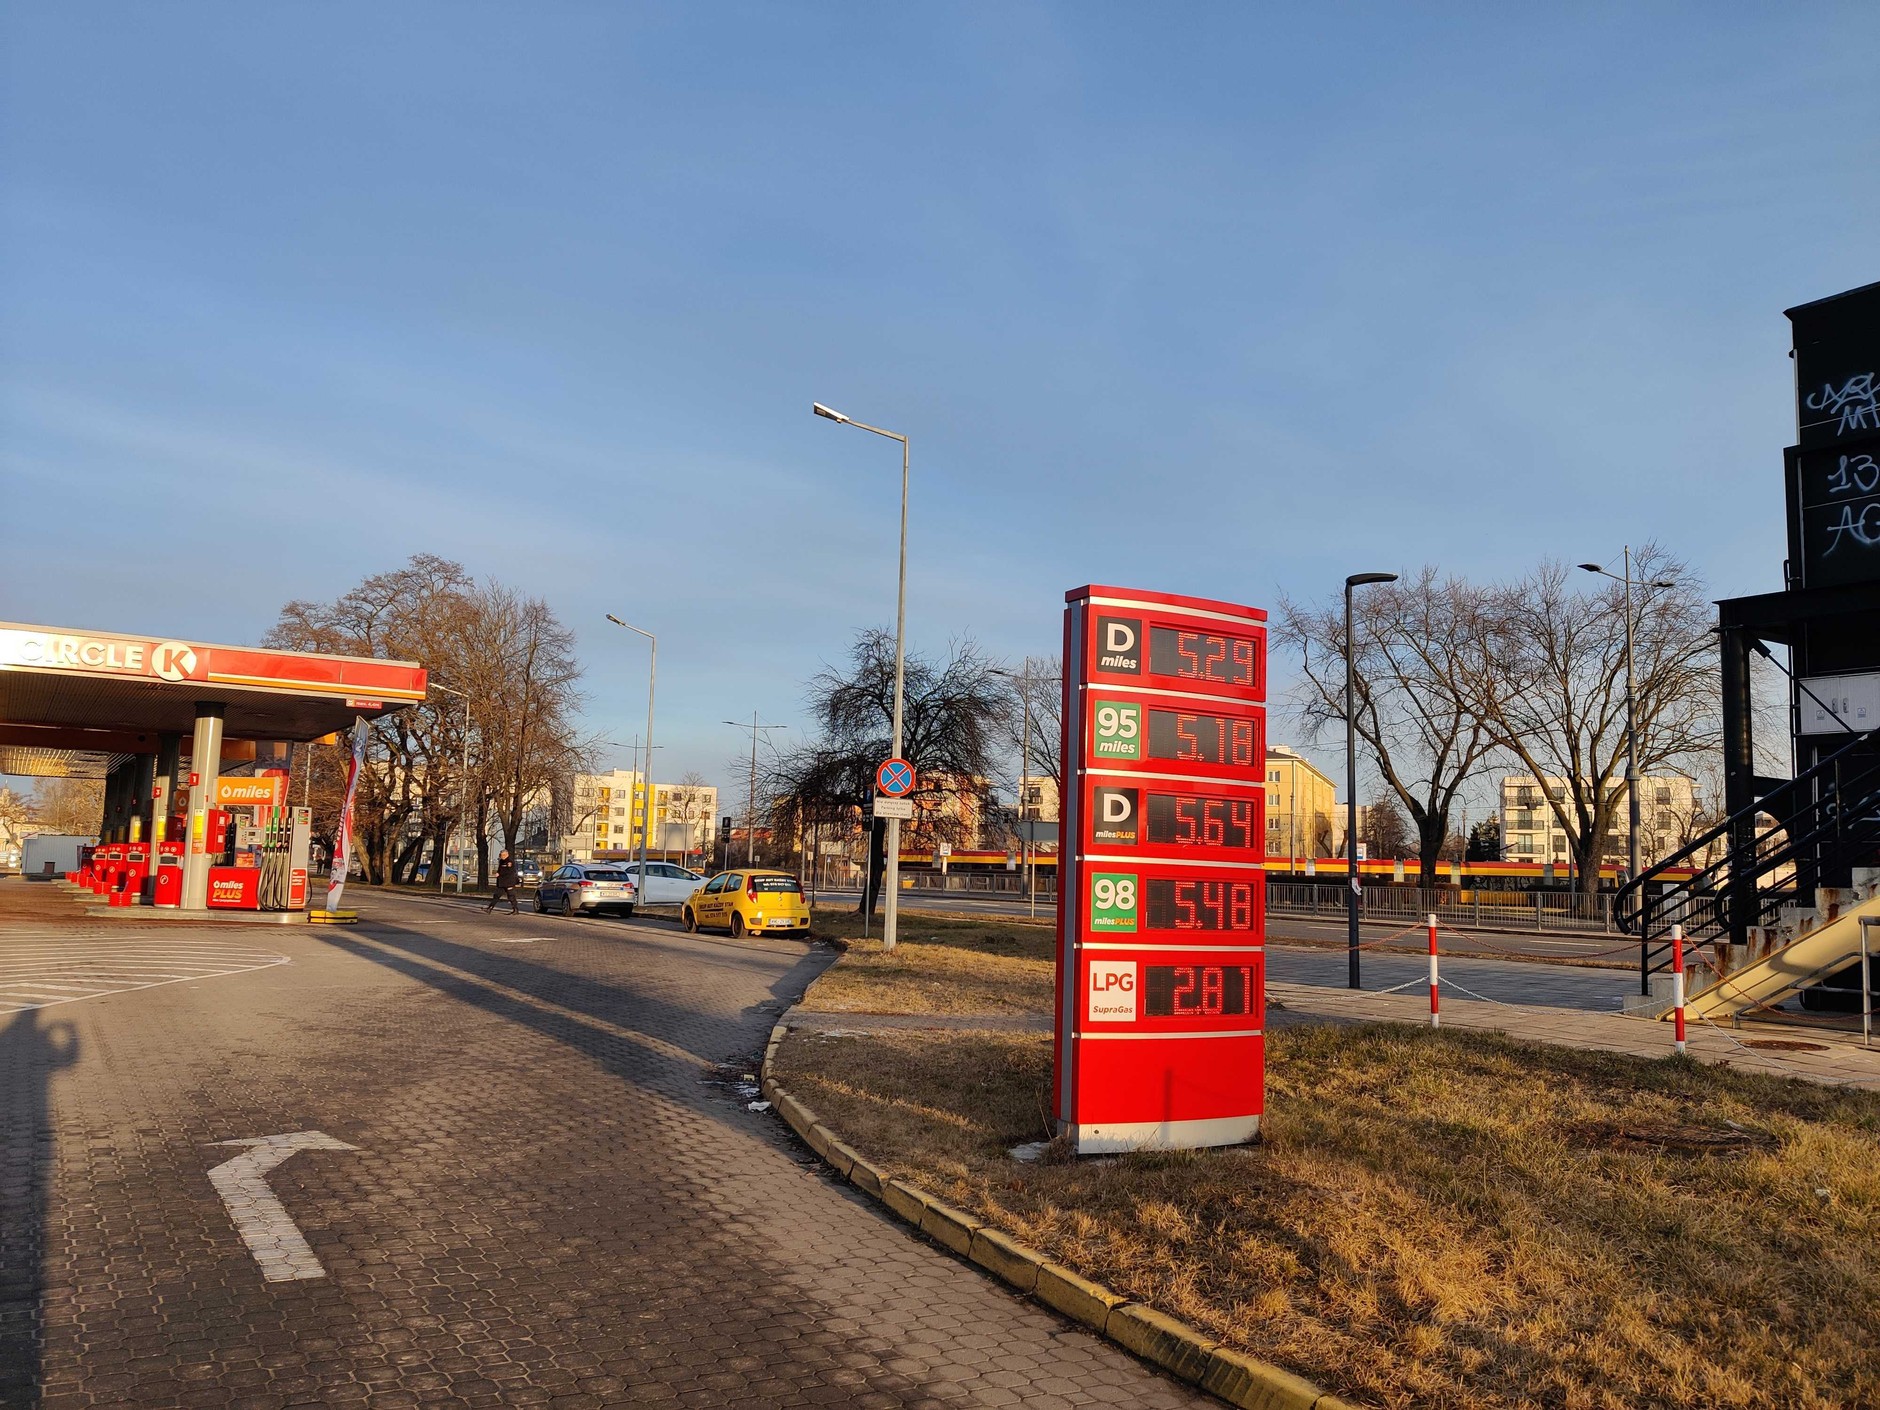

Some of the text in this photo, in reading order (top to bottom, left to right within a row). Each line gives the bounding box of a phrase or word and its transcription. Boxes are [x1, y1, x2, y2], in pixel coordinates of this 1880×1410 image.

[1106, 623, 1135, 652] D
[19, 637, 191, 680] CIRCLE K
[1101, 655, 1137, 669] miles
[1177, 632, 1254, 685] 5.29
[1097, 707, 1137, 739] 95
[1099, 740, 1136, 754] miles
[232, 785, 271, 799] miles
[1103, 793, 1132, 823] D
[1095, 829, 1136, 840] milesPLUS
[1175, 797, 1252, 848] 5.64
[213, 889, 243, 899] PLUS
[219, 880, 244, 889] miles
[1094, 879, 1136, 910] 98
[1175, 881, 1251, 930] 5.48
[1094, 916, 1135, 926] milesPLUS
[1093, 973, 1134, 992] LPG
[1174, 967, 1251, 1015] 2.81
[1093, 1005, 1133, 1015] SupraGas
